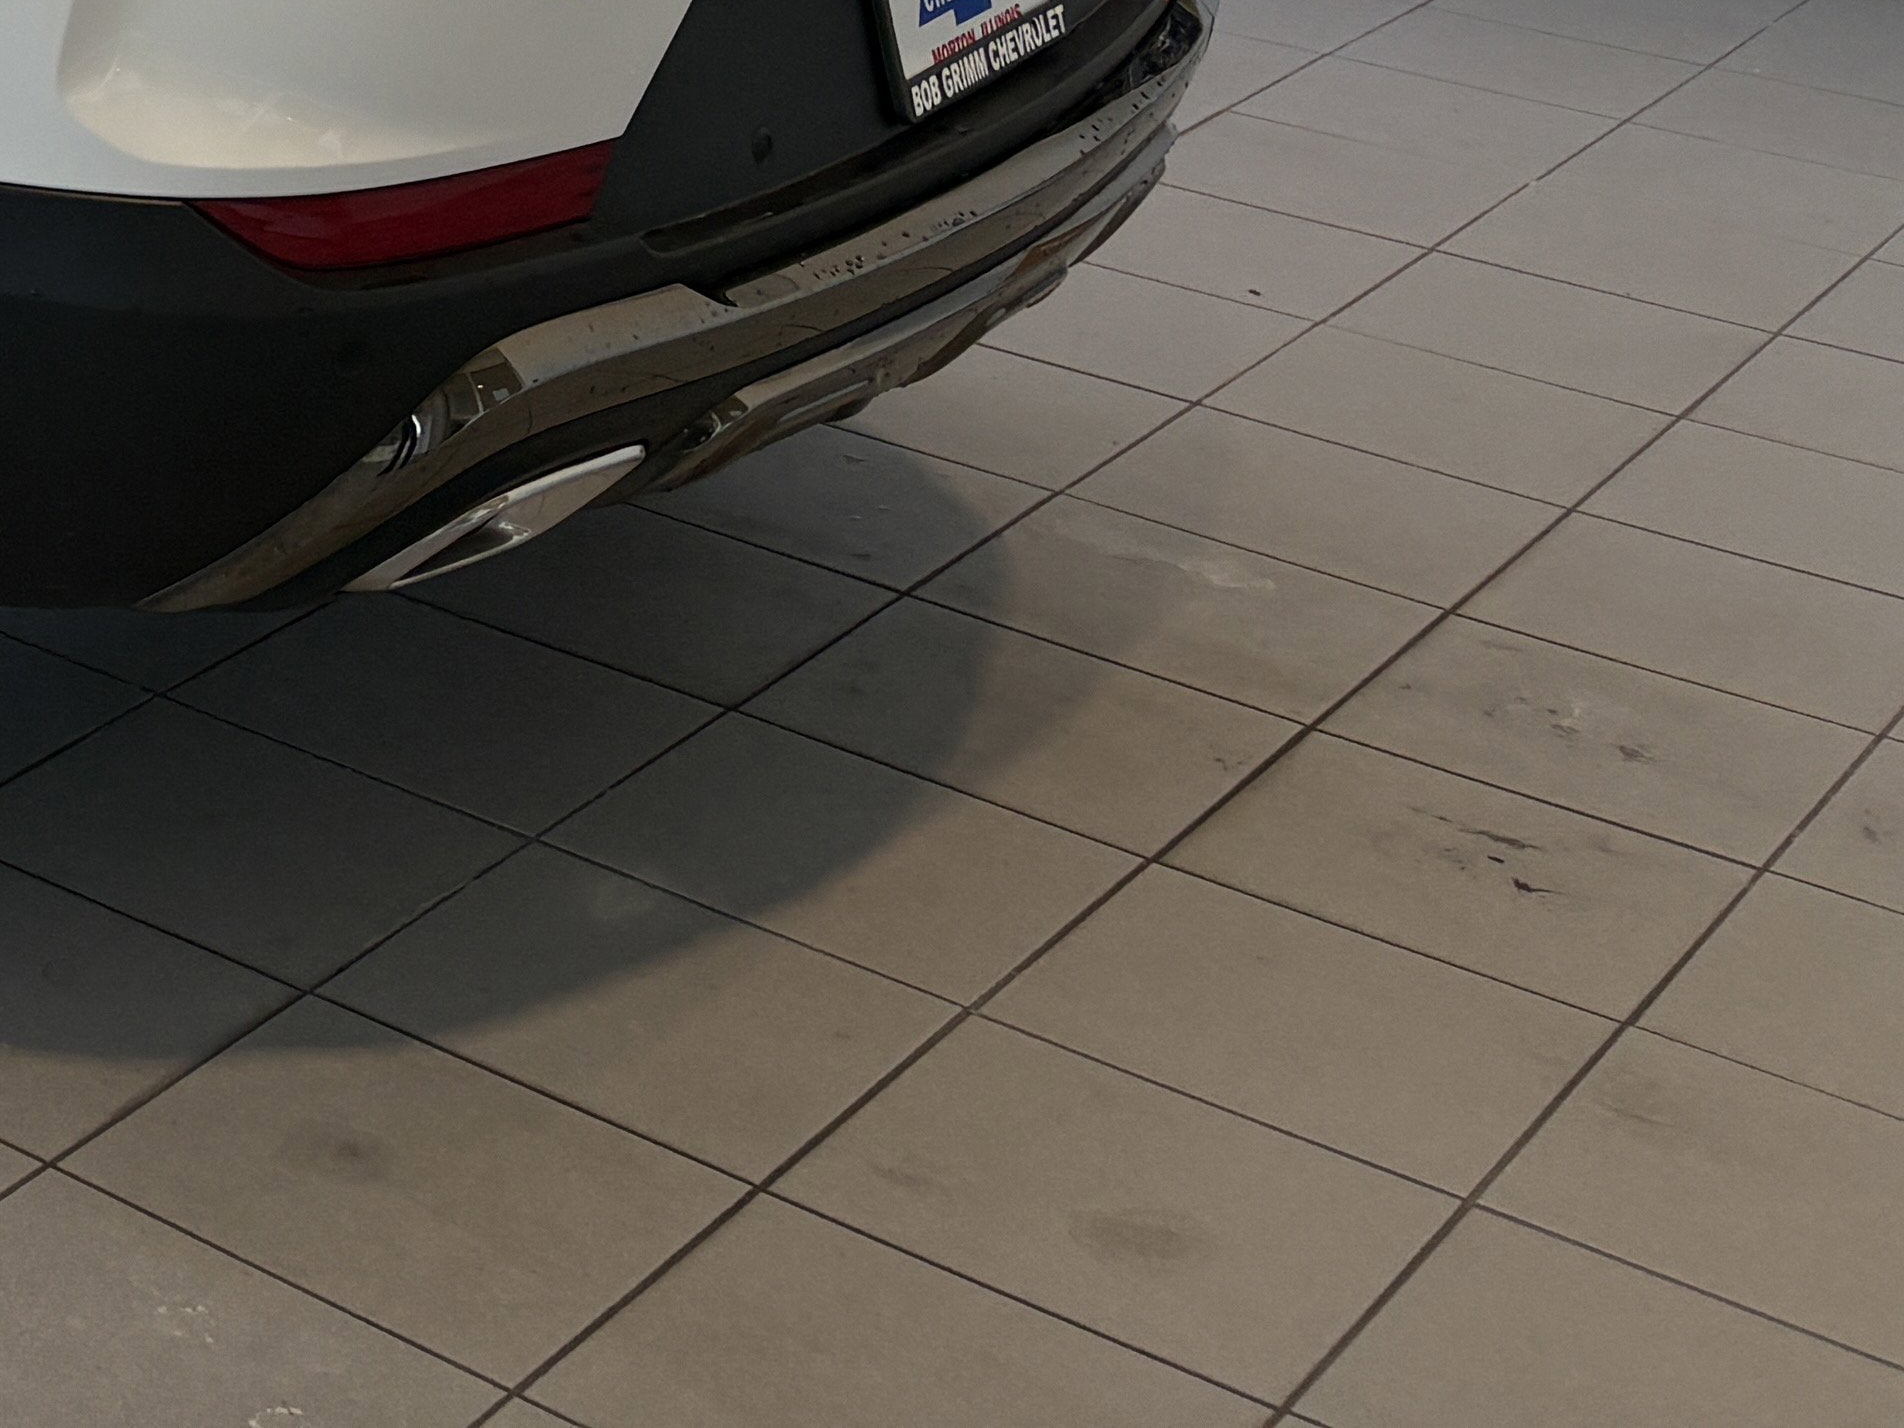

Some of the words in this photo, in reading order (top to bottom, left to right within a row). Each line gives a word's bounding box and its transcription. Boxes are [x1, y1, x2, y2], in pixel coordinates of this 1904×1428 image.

[911, 74, 942, 117] BOB
[941, 49, 990, 99] GRIMM
[988, 4, 1065, 72] CHEVROLET
